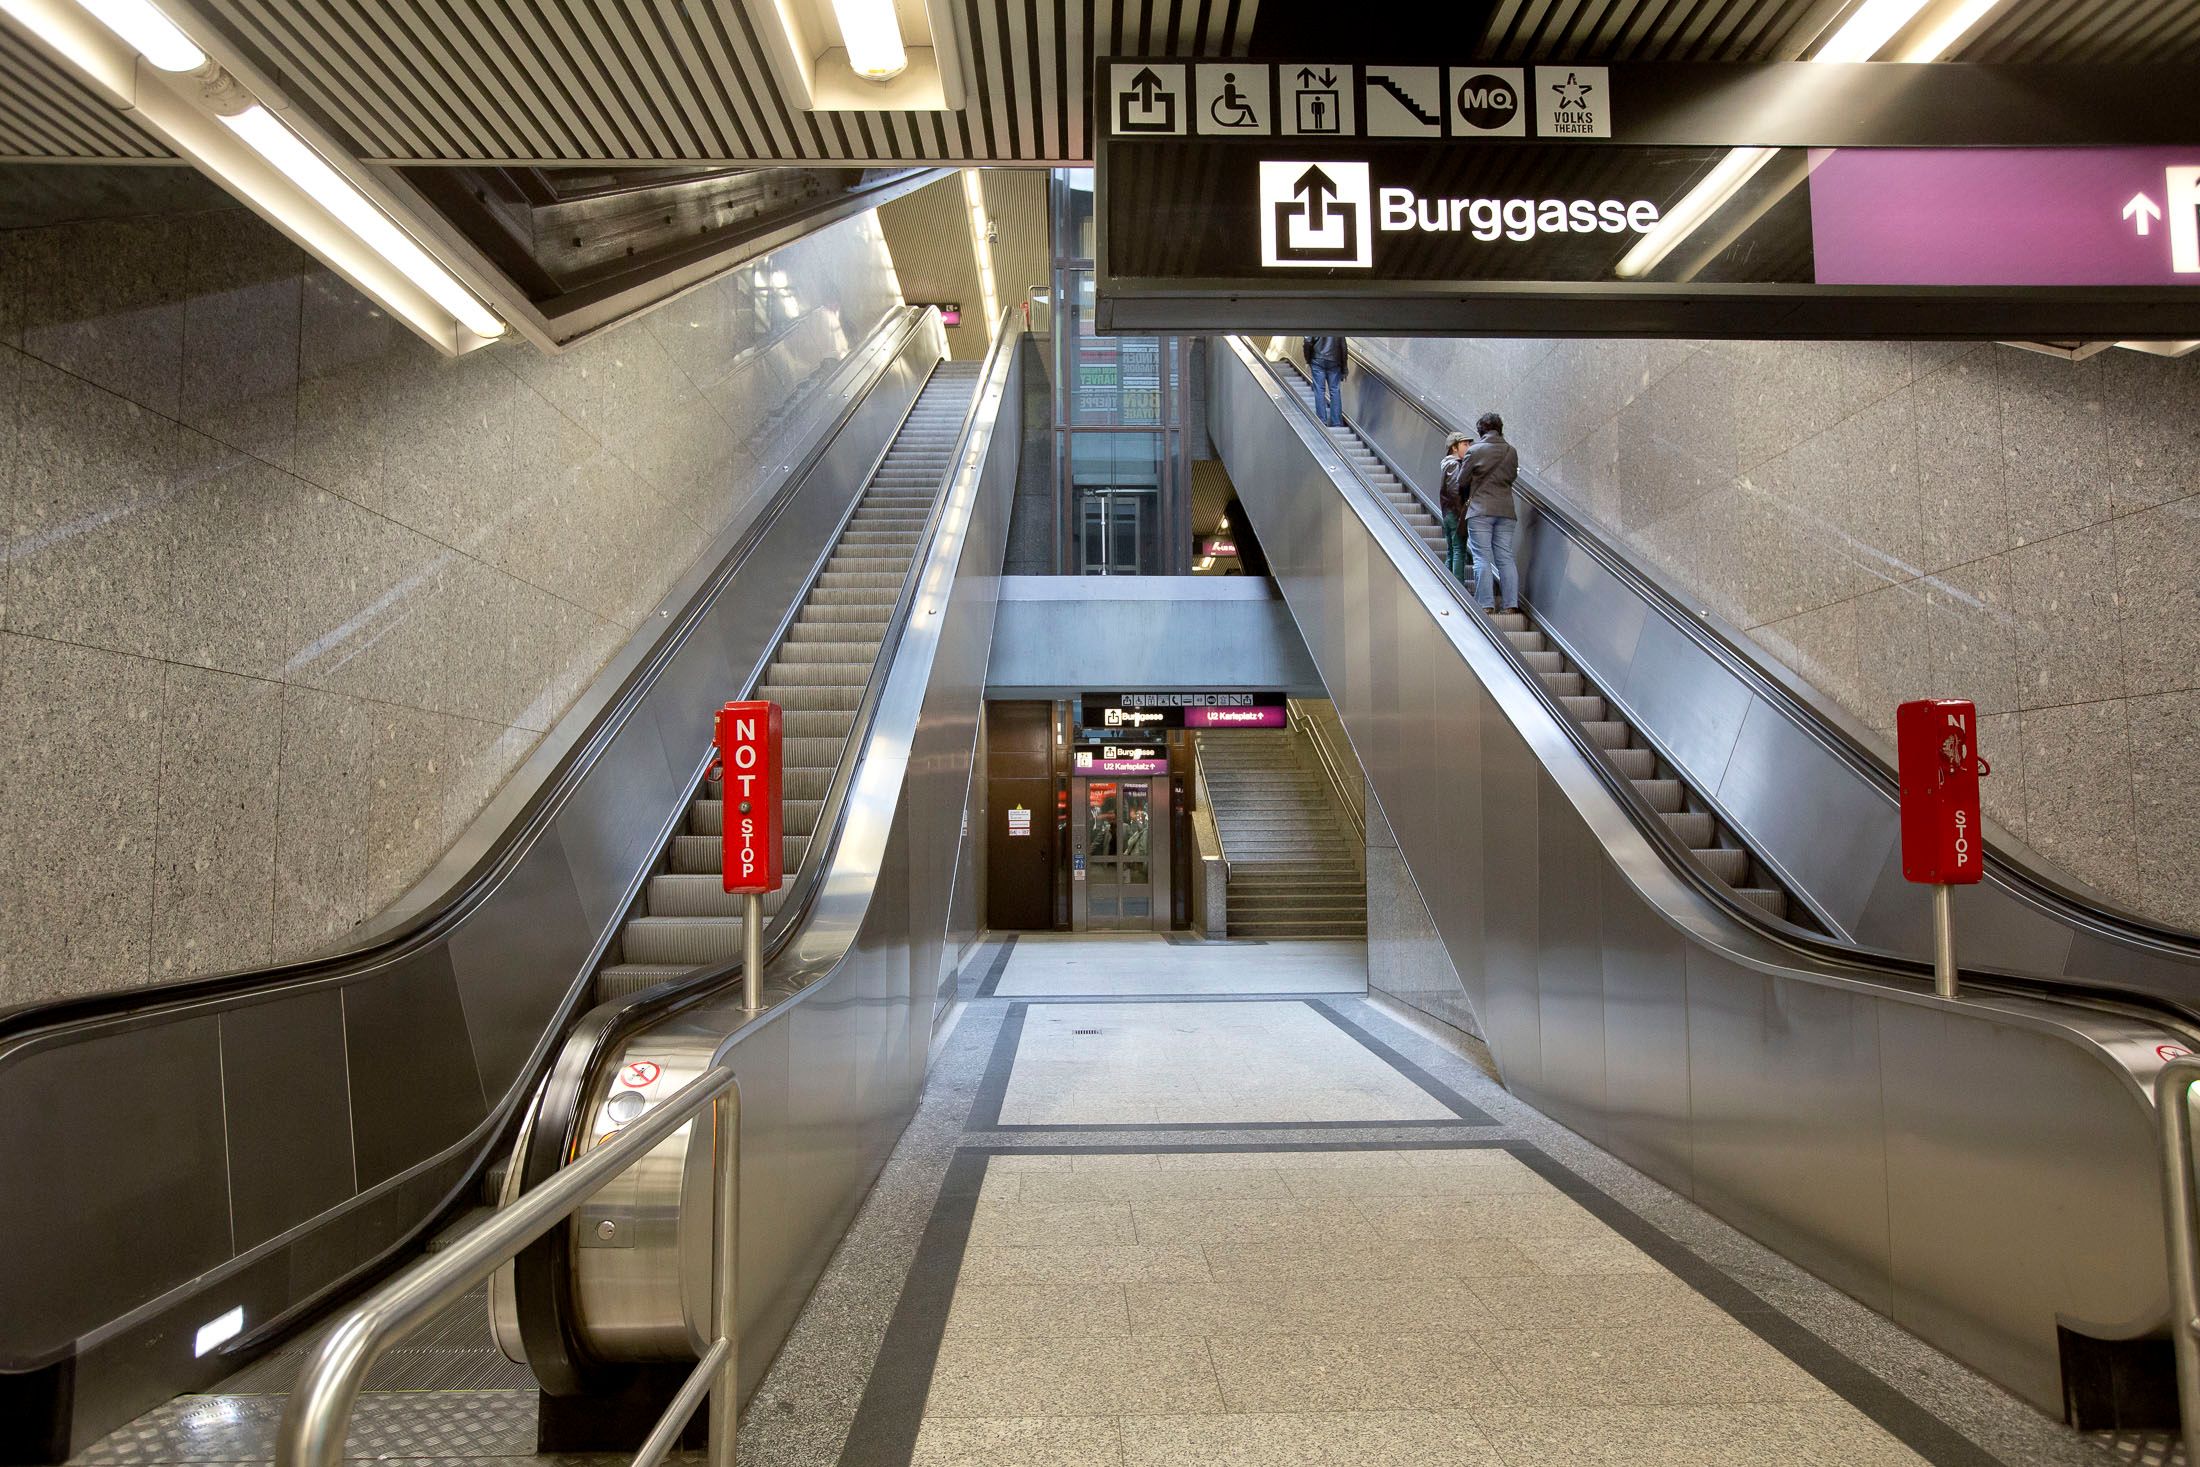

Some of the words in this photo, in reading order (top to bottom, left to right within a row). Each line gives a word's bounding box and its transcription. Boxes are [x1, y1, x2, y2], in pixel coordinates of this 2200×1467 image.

[1464, 88, 1513, 109] MQ
[1554, 111, 1593, 123] VOLKS
[1554, 124, 1593, 133] THEATER
[1379, 187, 1659, 242] Burggasse
[1207, 712, 1218, 720] U2
[736, 719, 756, 797] NOT
[1104, 762, 1114, 770] U2
[741, 818, 754, 878] STOP
[1955, 810, 1968, 867] STOP
